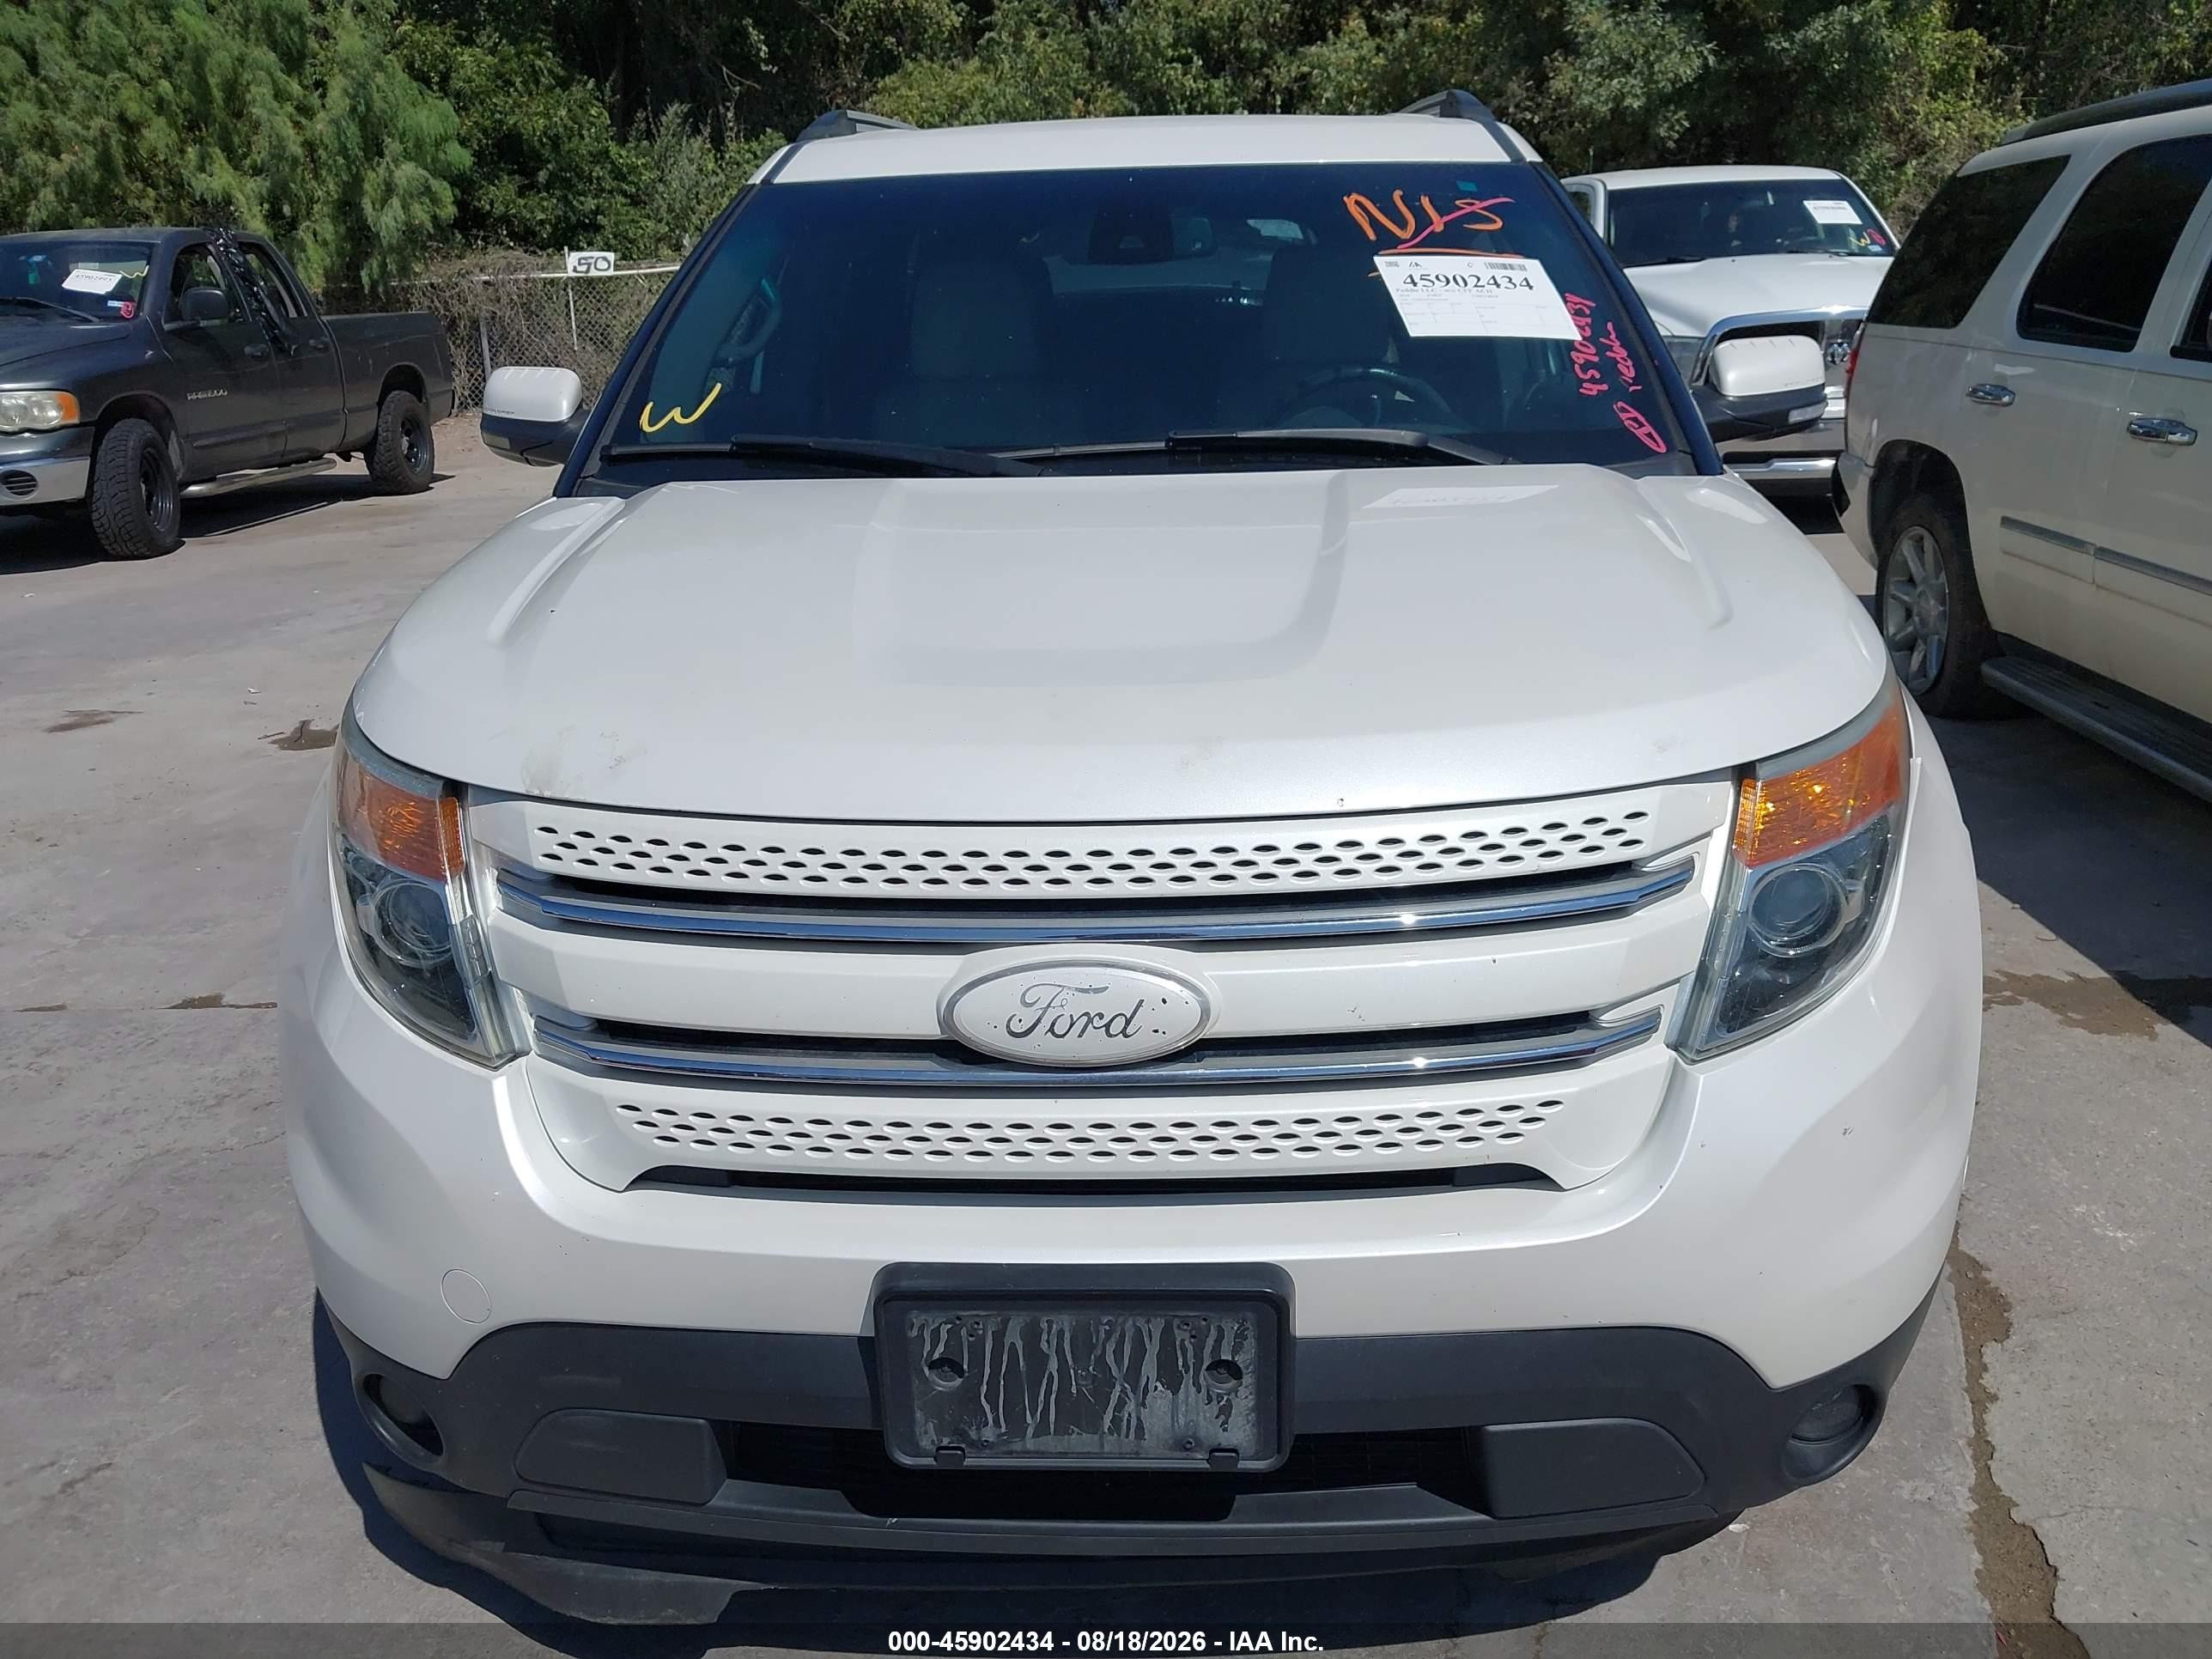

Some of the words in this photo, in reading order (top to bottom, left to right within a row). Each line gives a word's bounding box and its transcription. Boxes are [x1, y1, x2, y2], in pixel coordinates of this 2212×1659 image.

[572, 256, 611, 274] 50
[1402, 273, 1534, 291] 45902434
[1006, 982, 1146, 1039] Ford
